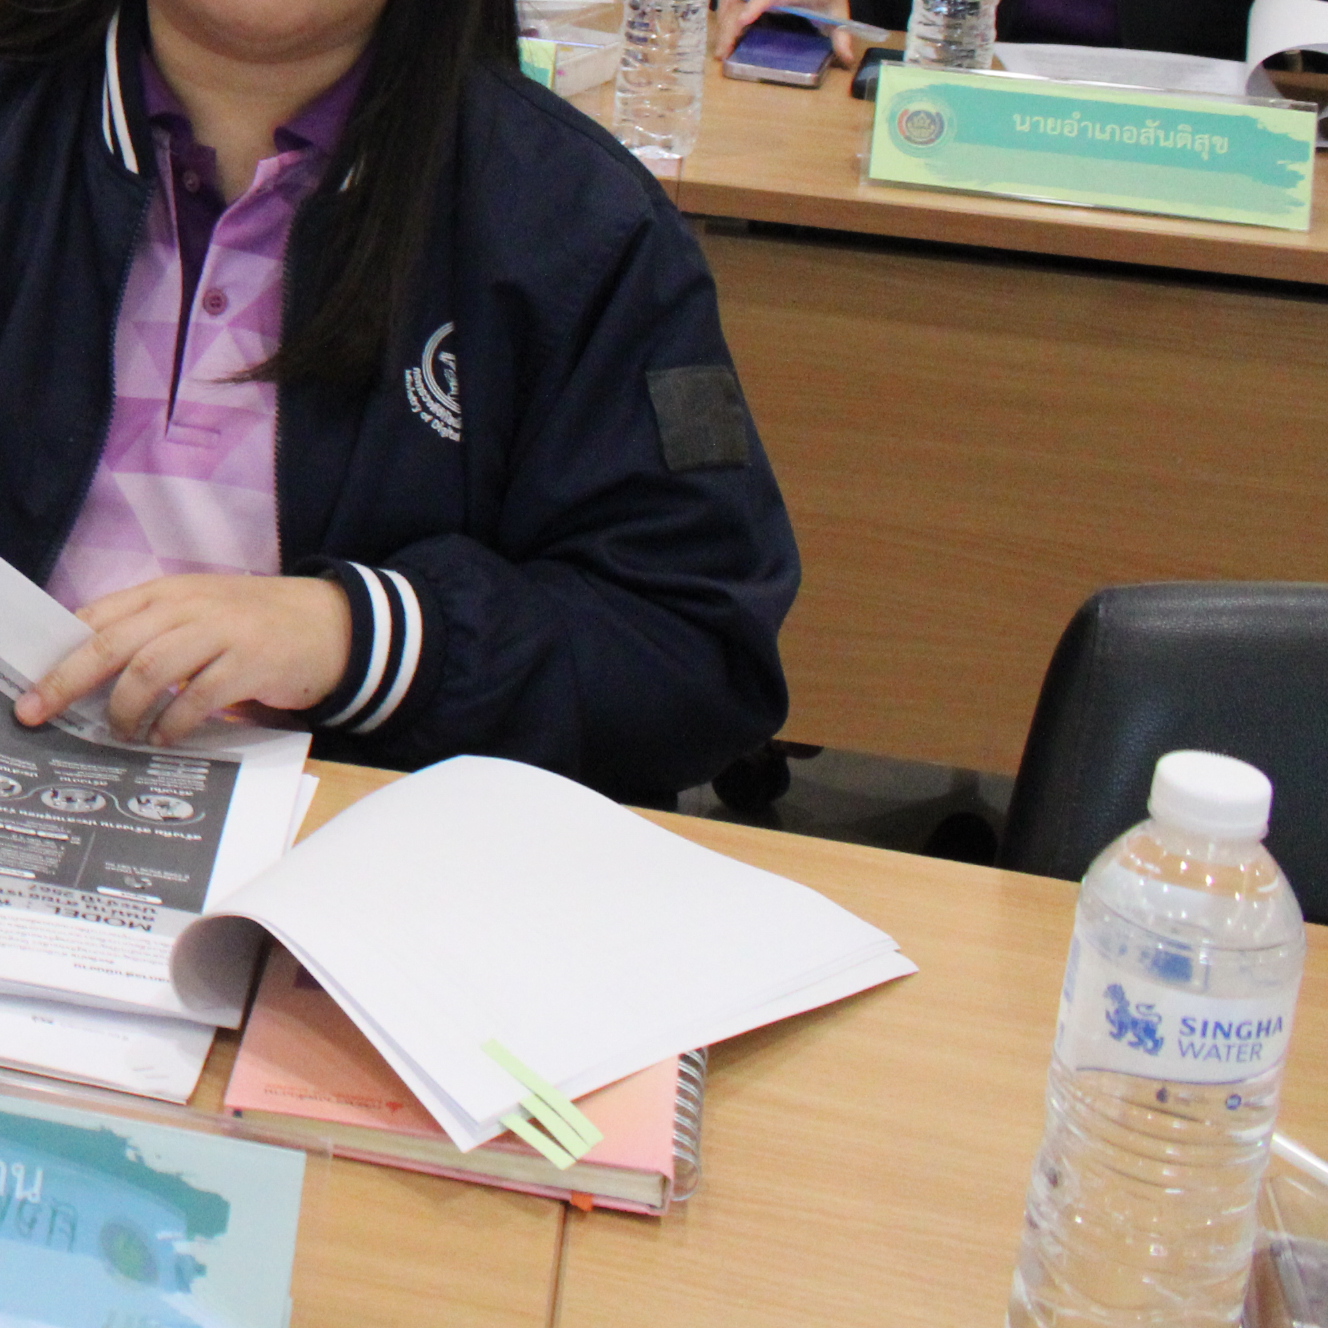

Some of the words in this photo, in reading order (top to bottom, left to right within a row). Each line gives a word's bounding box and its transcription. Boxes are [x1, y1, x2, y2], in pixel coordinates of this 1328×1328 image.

[1013, 111, 1229, 161] นายอำเภอสันติสุข
[53, 906, 153, 932] MODEL
[1179, 1016, 1284, 1041] SINGHA
[1178, 1038, 1264, 1063] WATER
